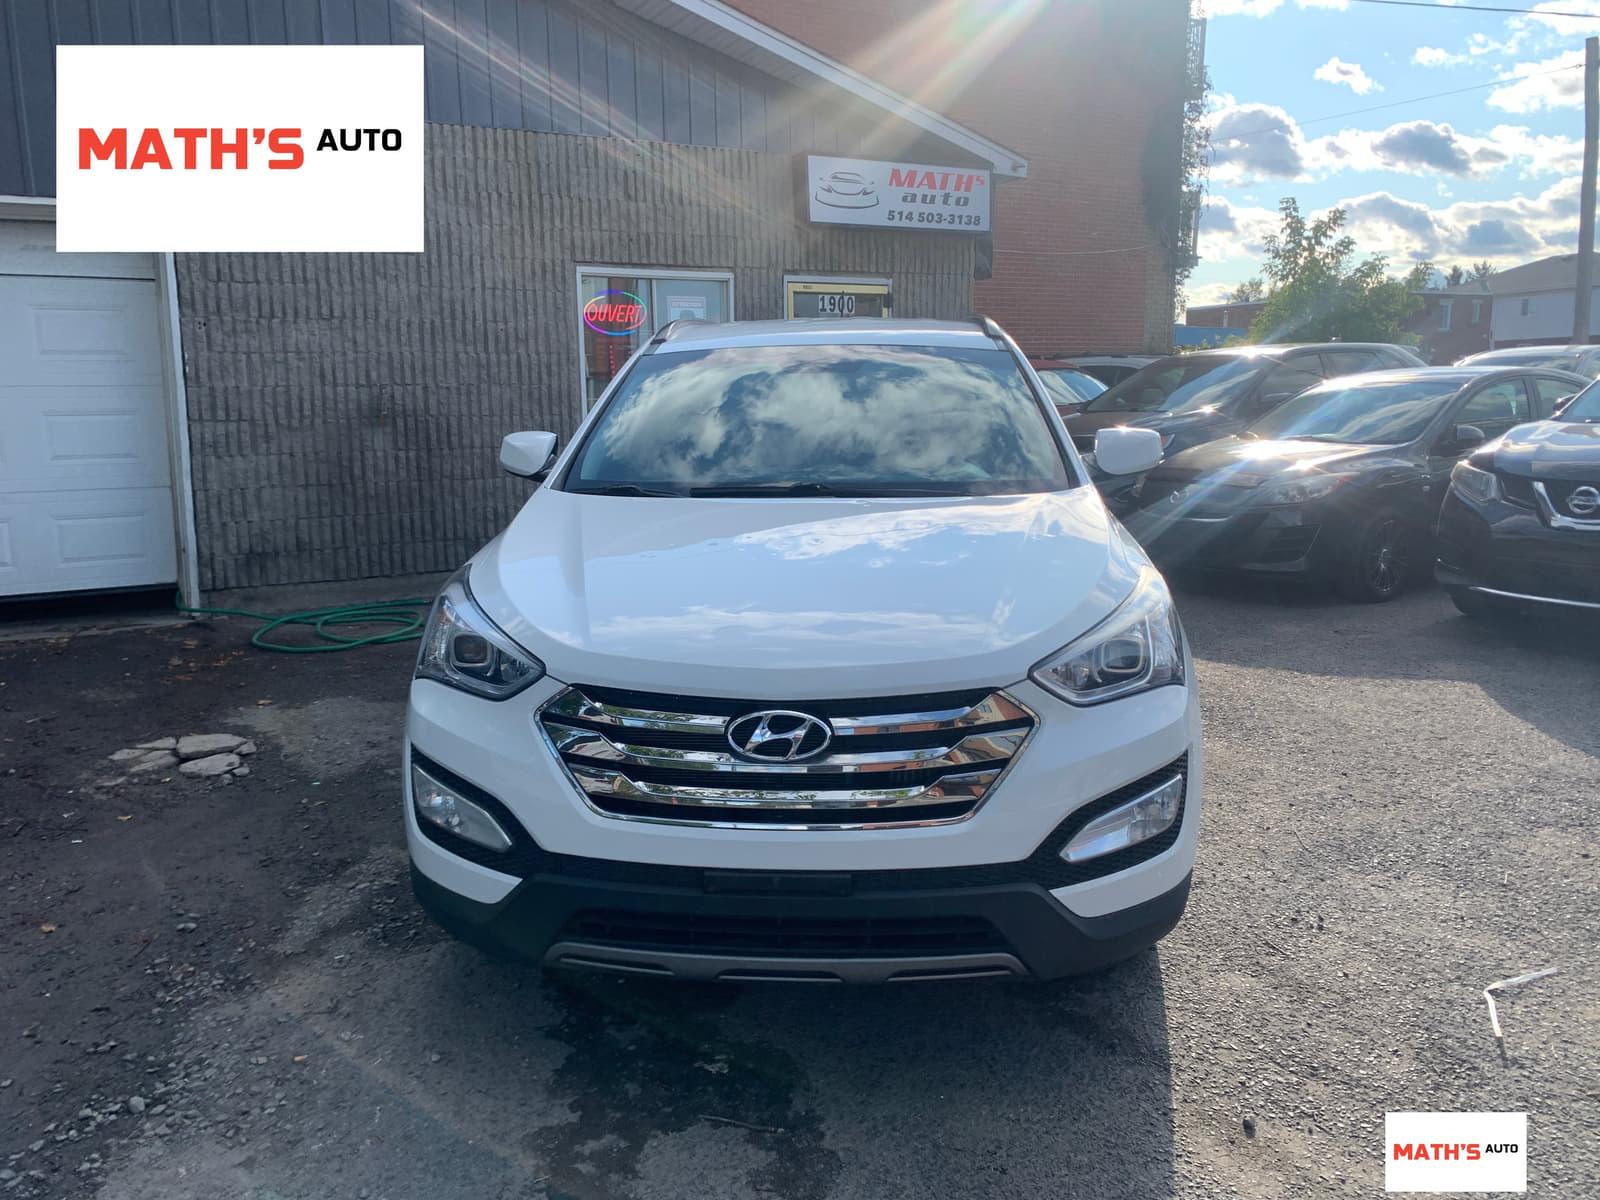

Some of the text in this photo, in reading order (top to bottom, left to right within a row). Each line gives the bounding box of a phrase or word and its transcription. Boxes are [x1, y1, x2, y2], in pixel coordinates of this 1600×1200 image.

[902, 192, 969, 206] auto
[887, 210, 981, 226] 514 503-3138
[819, 296, 854, 313] 1900
[587, 303, 642, 323] OUVERT
